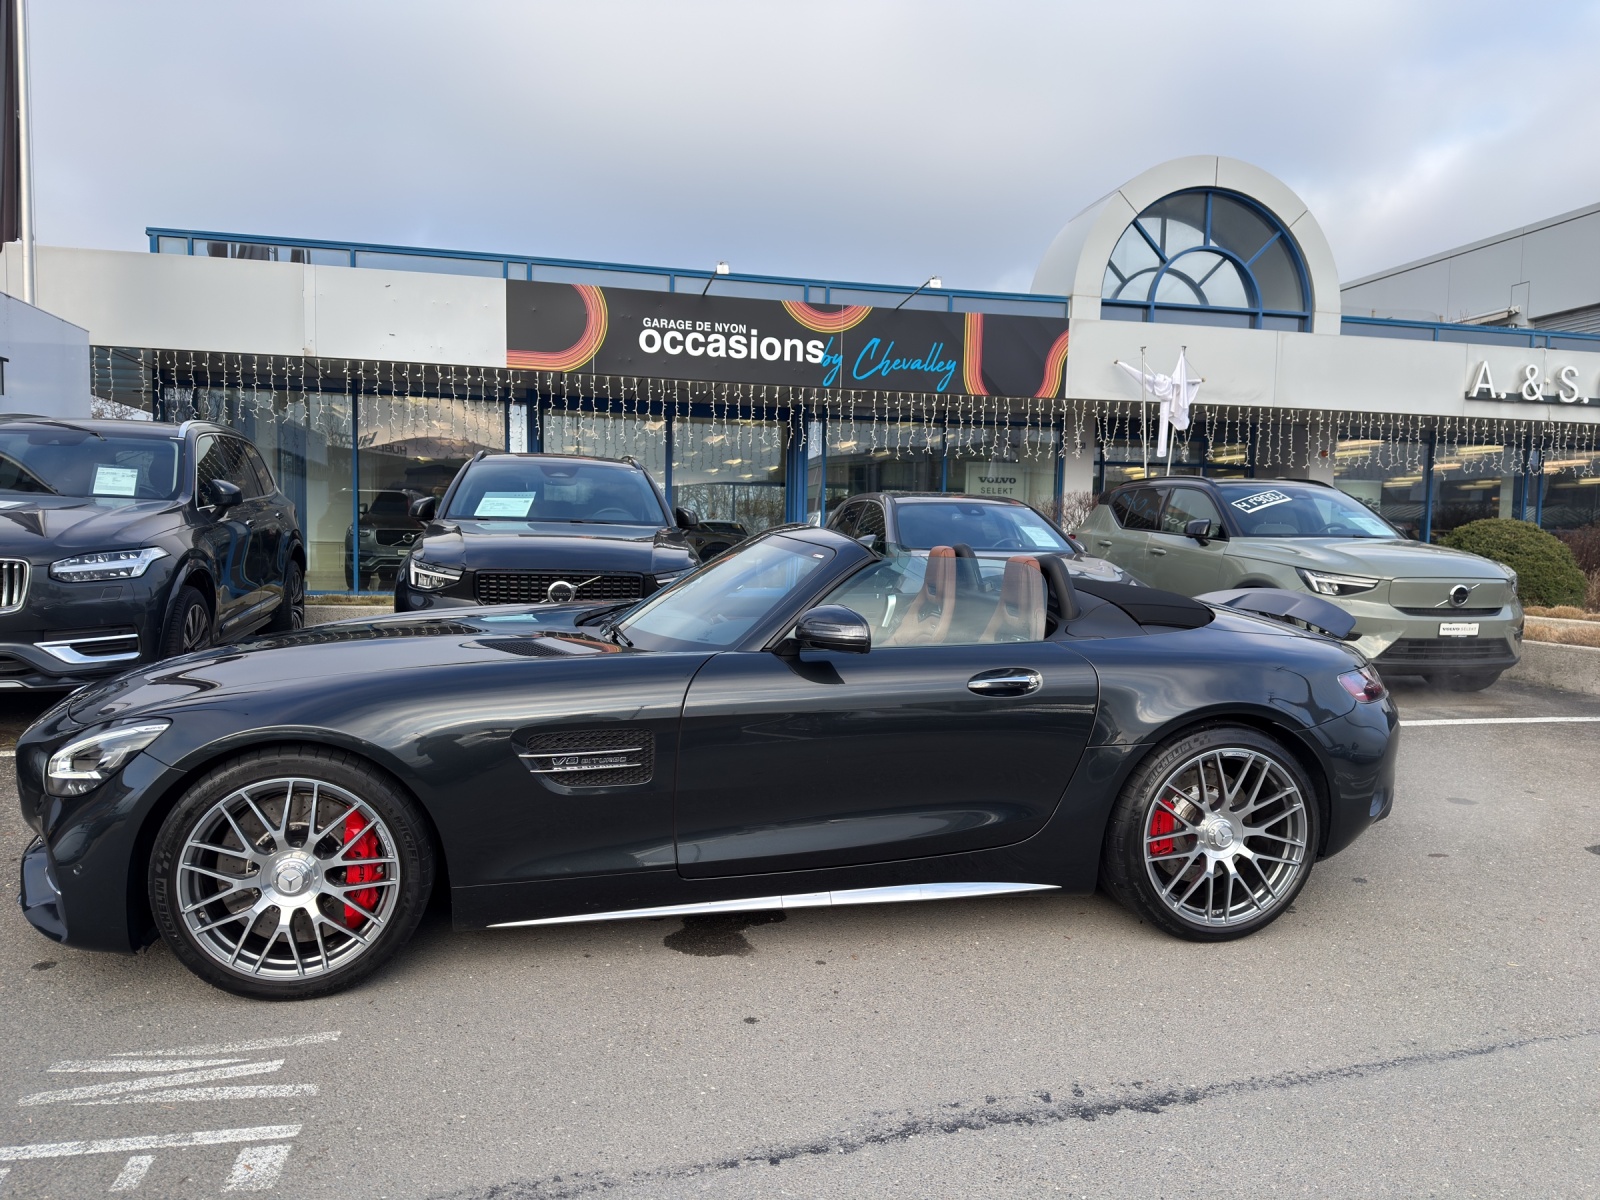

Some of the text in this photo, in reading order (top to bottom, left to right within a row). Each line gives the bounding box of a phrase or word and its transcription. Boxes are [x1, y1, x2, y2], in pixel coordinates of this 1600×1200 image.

[642, 317, 747, 334] GARAGE DE NYON
[638, 328, 957, 392] occasions by Chevalley
[1468, 360, 1507, 399] A.
[1521, 364, 1545, 401] &
[1557, 365, 1590, 404] S.
[978, 476, 1017, 484] VOLVO
[980, 487, 1014, 495] SELEKT
[1147, 742, 1192, 786] MICHELIN
